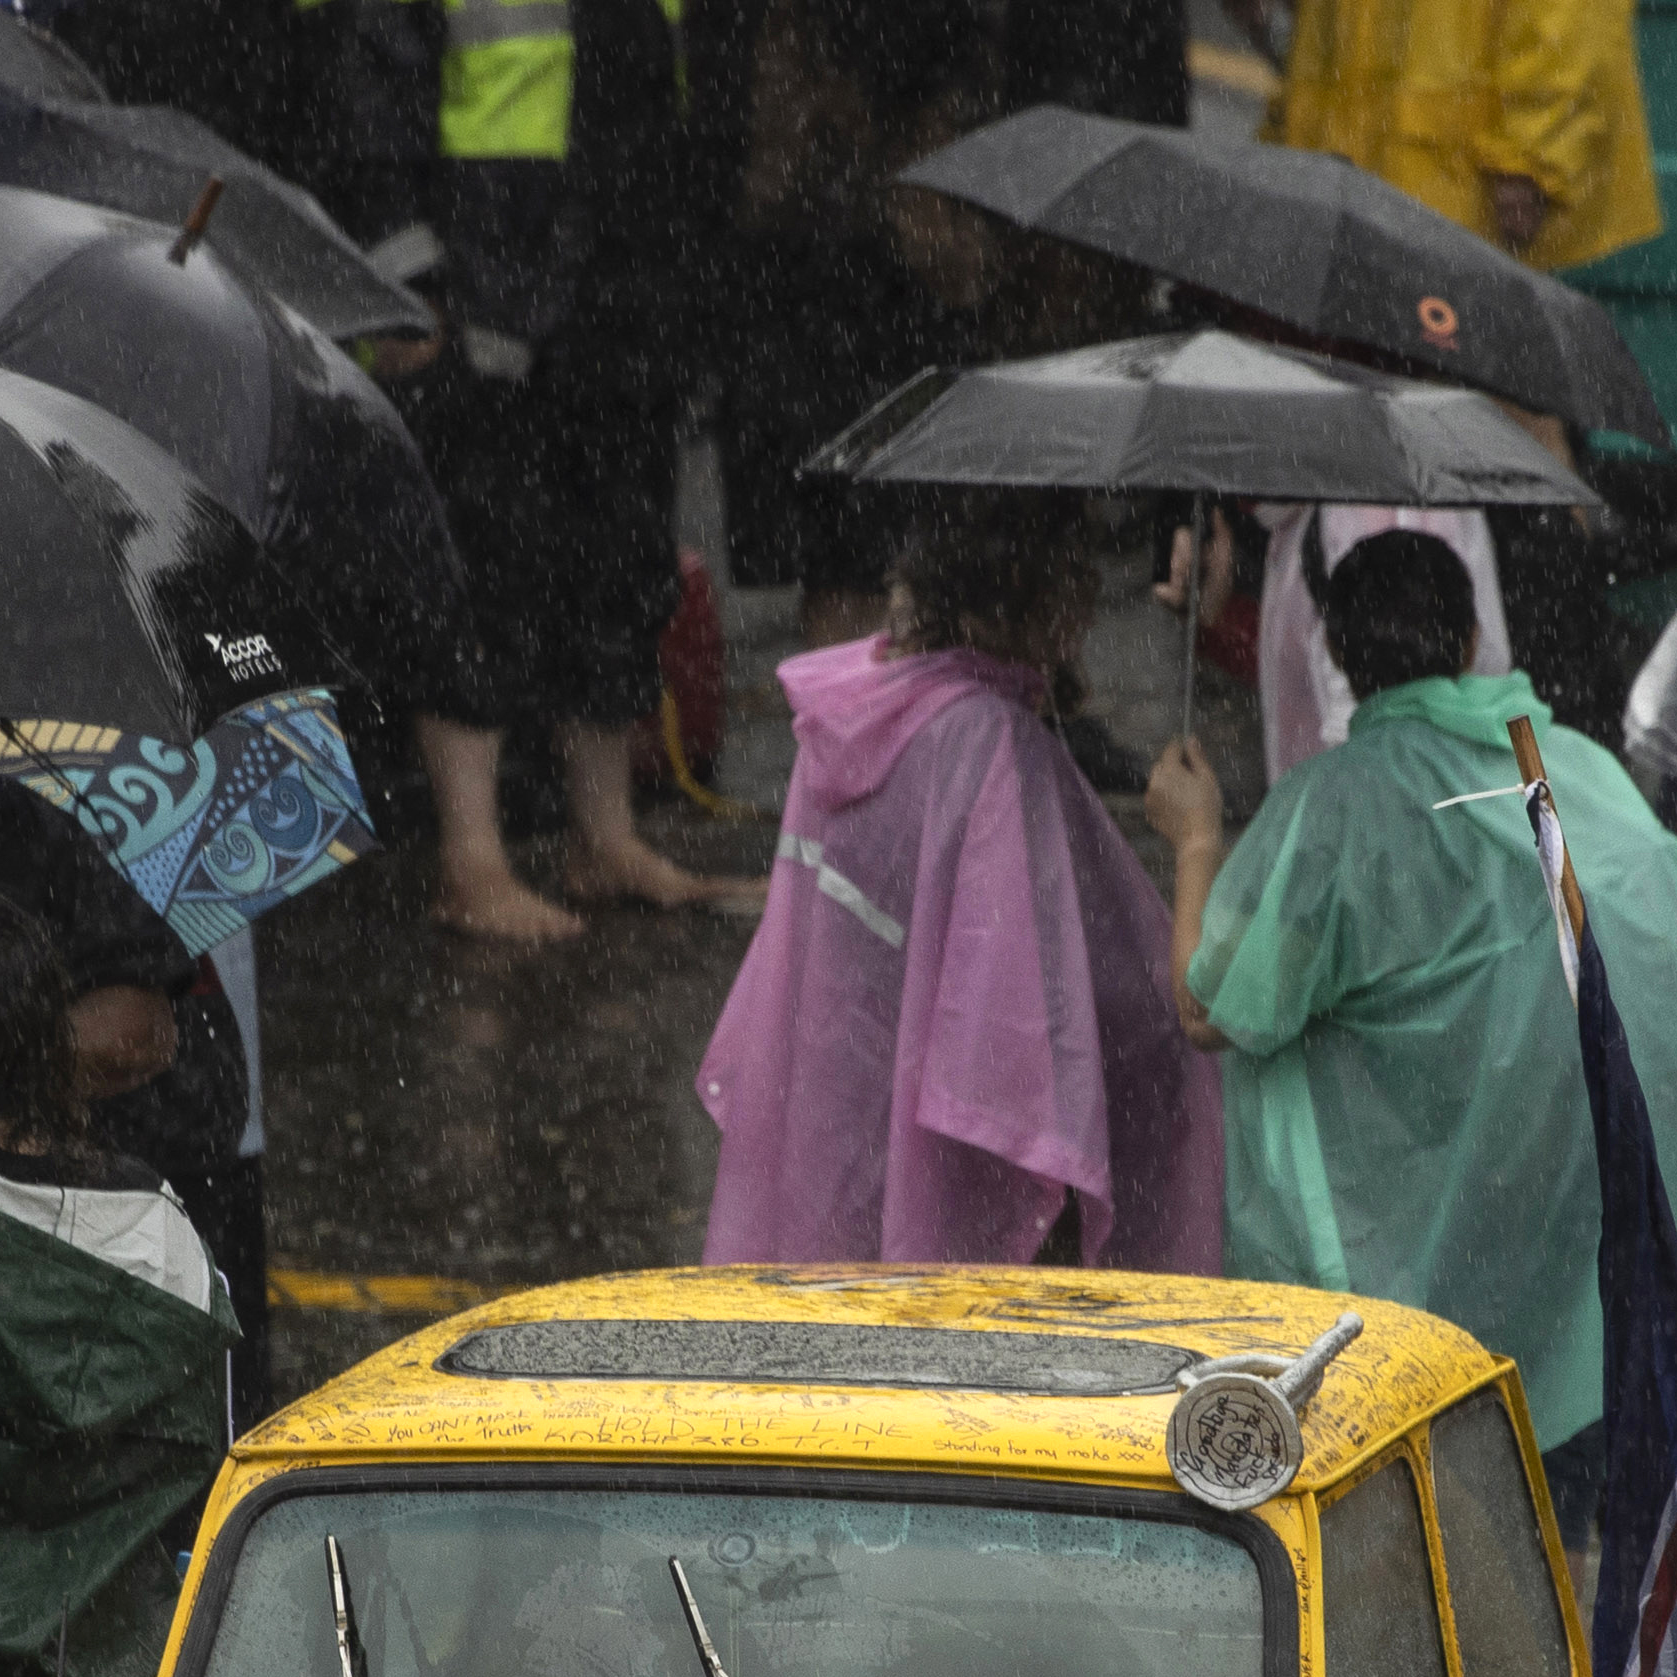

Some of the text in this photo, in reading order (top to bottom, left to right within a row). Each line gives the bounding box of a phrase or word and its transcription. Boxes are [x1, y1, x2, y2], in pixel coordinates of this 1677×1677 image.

[220, 633, 273, 668] ACCOR
[228, 653, 283, 684] HOTELS
[598, 1416, 913, 1441] HOLD THE LINE
[934, 1439, 1000, 1456] Standing
[1008, 1440, 1028, 1456] for
[1034, 1447, 1058, 1460] my
[1066, 1448, 1111, 1462] moko
